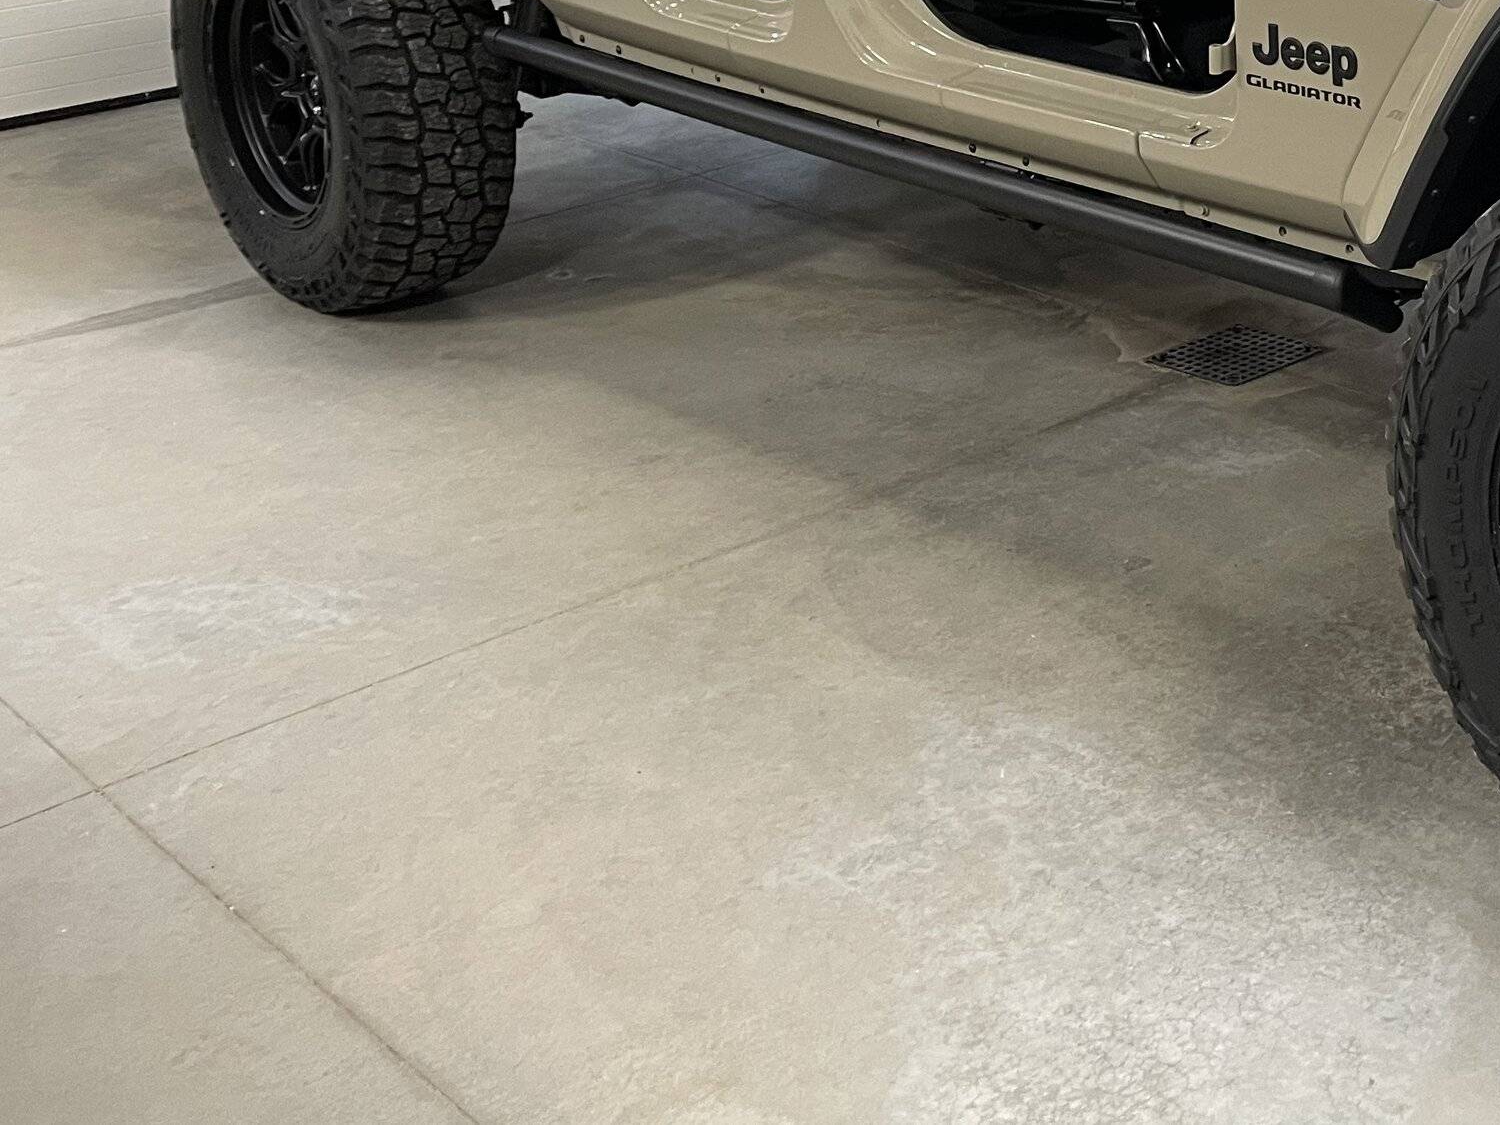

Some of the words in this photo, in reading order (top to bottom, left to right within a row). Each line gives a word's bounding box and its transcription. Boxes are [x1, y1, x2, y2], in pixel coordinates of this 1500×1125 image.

[1252, 23, 1358, 87] Jeep
[1246, 73, 1361, 110] GLADIATOR
[1444, 377, 1489, 638] THOMPSON
